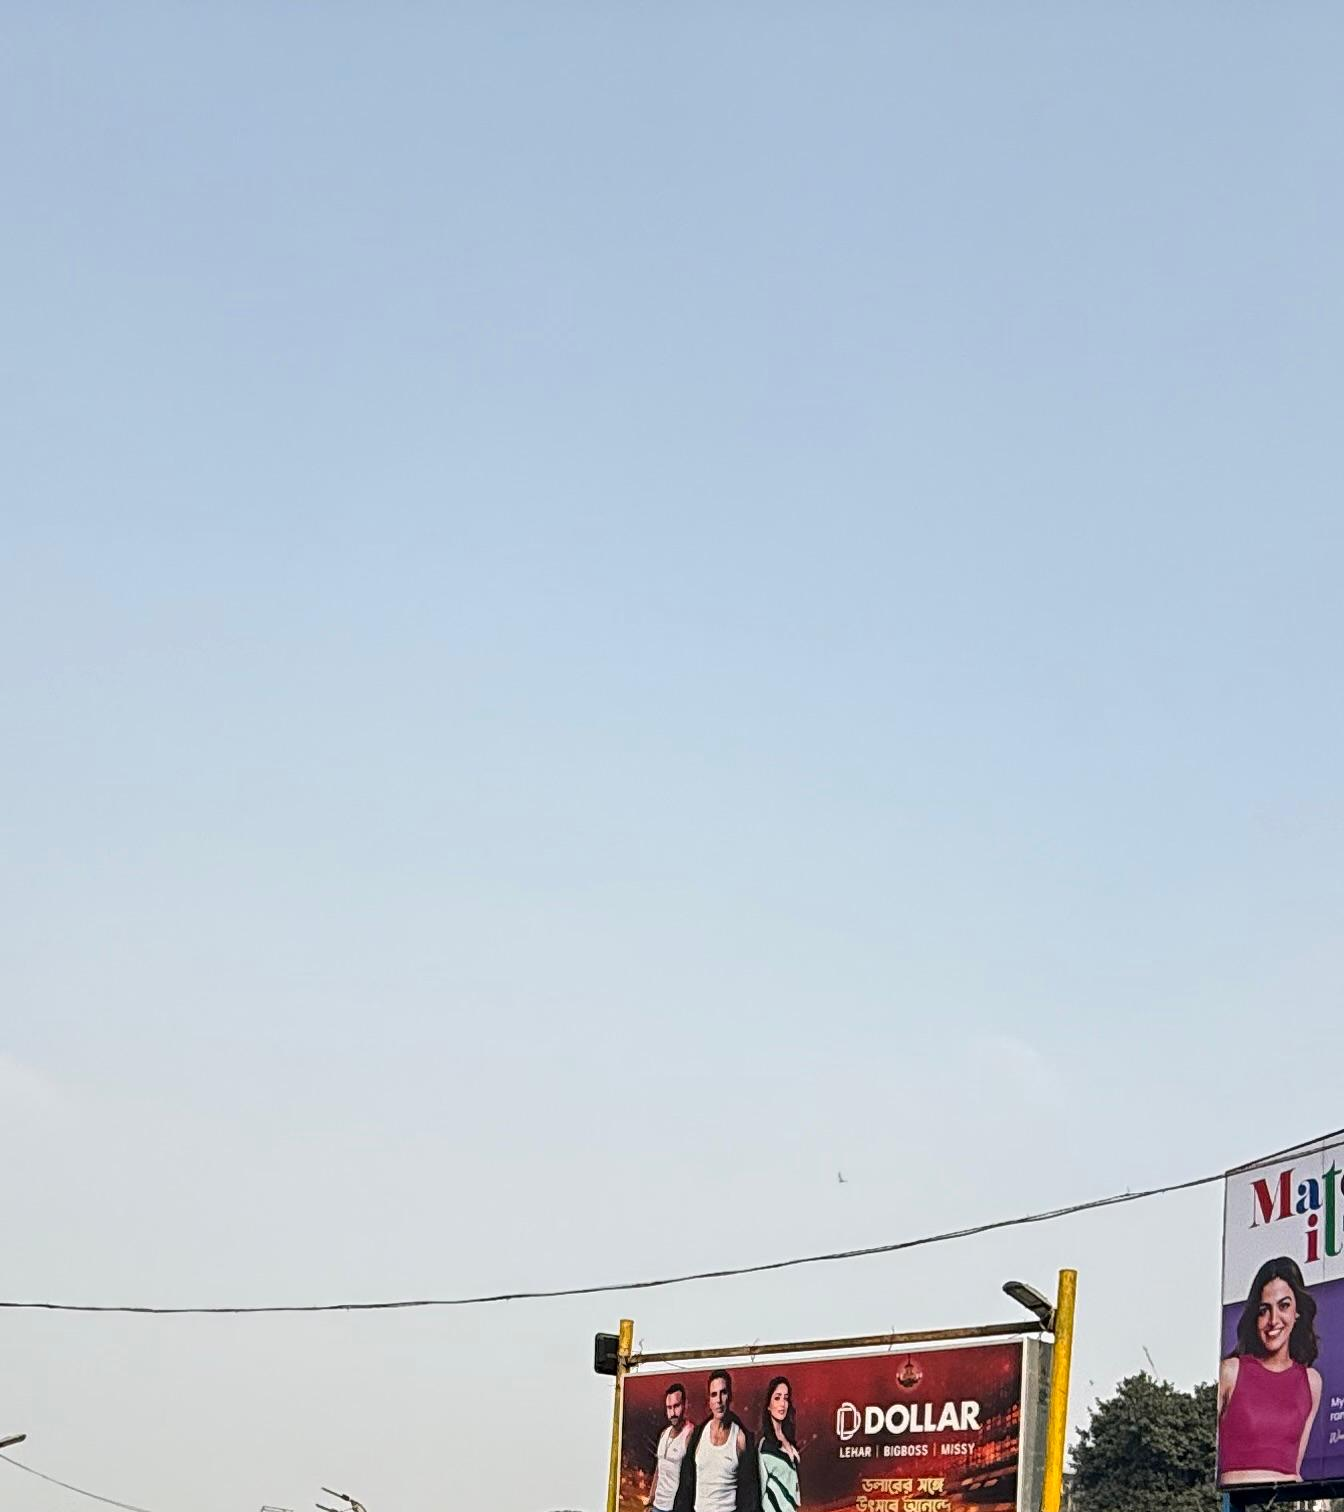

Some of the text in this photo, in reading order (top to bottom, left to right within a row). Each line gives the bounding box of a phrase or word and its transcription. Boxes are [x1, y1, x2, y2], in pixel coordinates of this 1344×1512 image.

[1304, 1213, 1343, 1264] it
[1330, 1397, 1344, 1409] My
[864, 1400, 982, 1435] DOLLAR
[839, 1442, 976, 1459] LEHAR BIGBOSS MISSY
